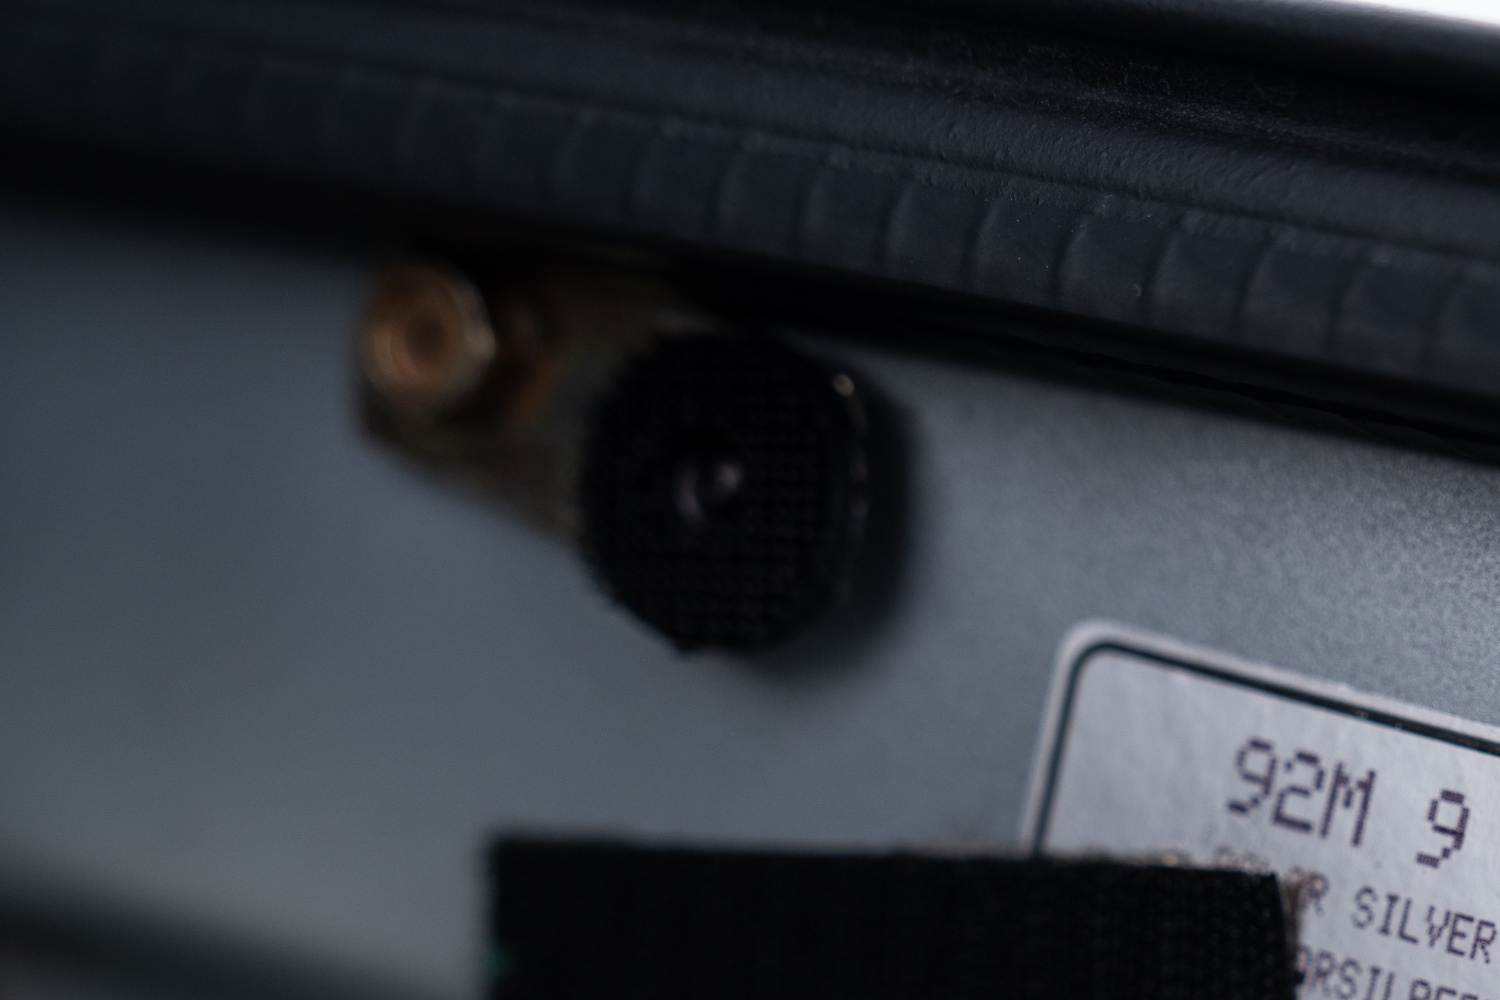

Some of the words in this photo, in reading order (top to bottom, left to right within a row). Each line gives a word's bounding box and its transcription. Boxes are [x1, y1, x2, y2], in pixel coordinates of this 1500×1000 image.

[1228, 738, 1376, 848] 92M
[1415, 788, 1470, 869] 9
[1350, 884, 1498, 965] SILVER
